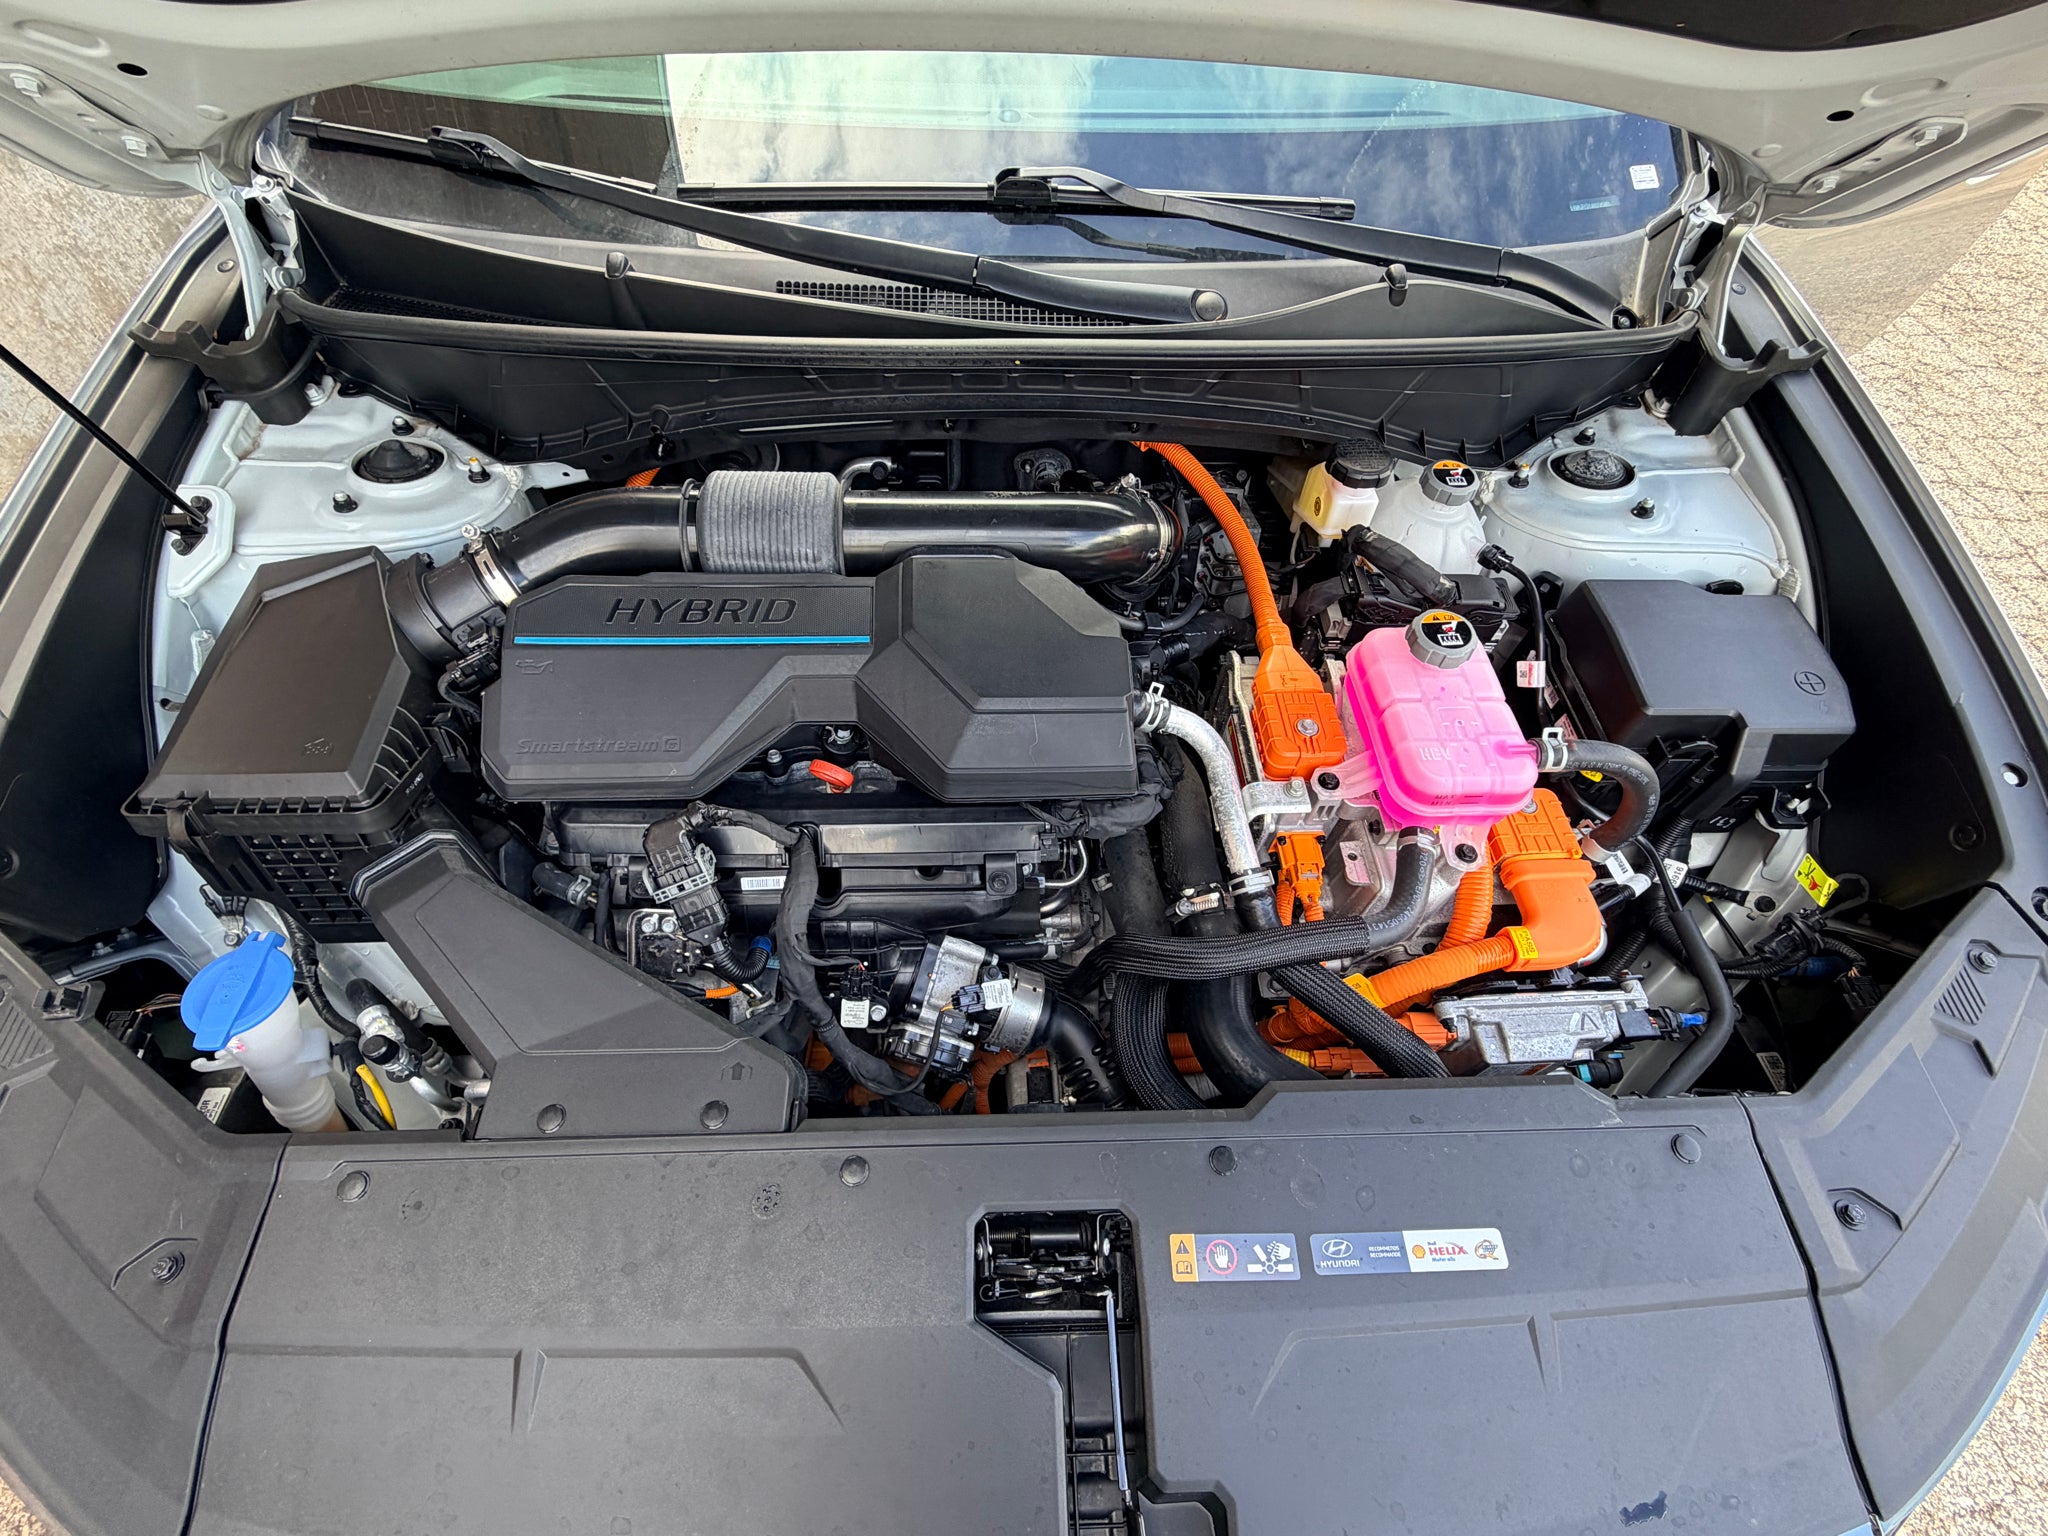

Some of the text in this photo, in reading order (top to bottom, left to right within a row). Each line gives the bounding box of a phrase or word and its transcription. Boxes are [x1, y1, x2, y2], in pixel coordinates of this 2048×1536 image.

[604, 598, 798, 625] HYBRID
[515, 738, 659, 754] Smartstream
[1429, 1246, 1468, 1256] HELIX
[1320, 1259, 1361, 1269] HYUNDAI
